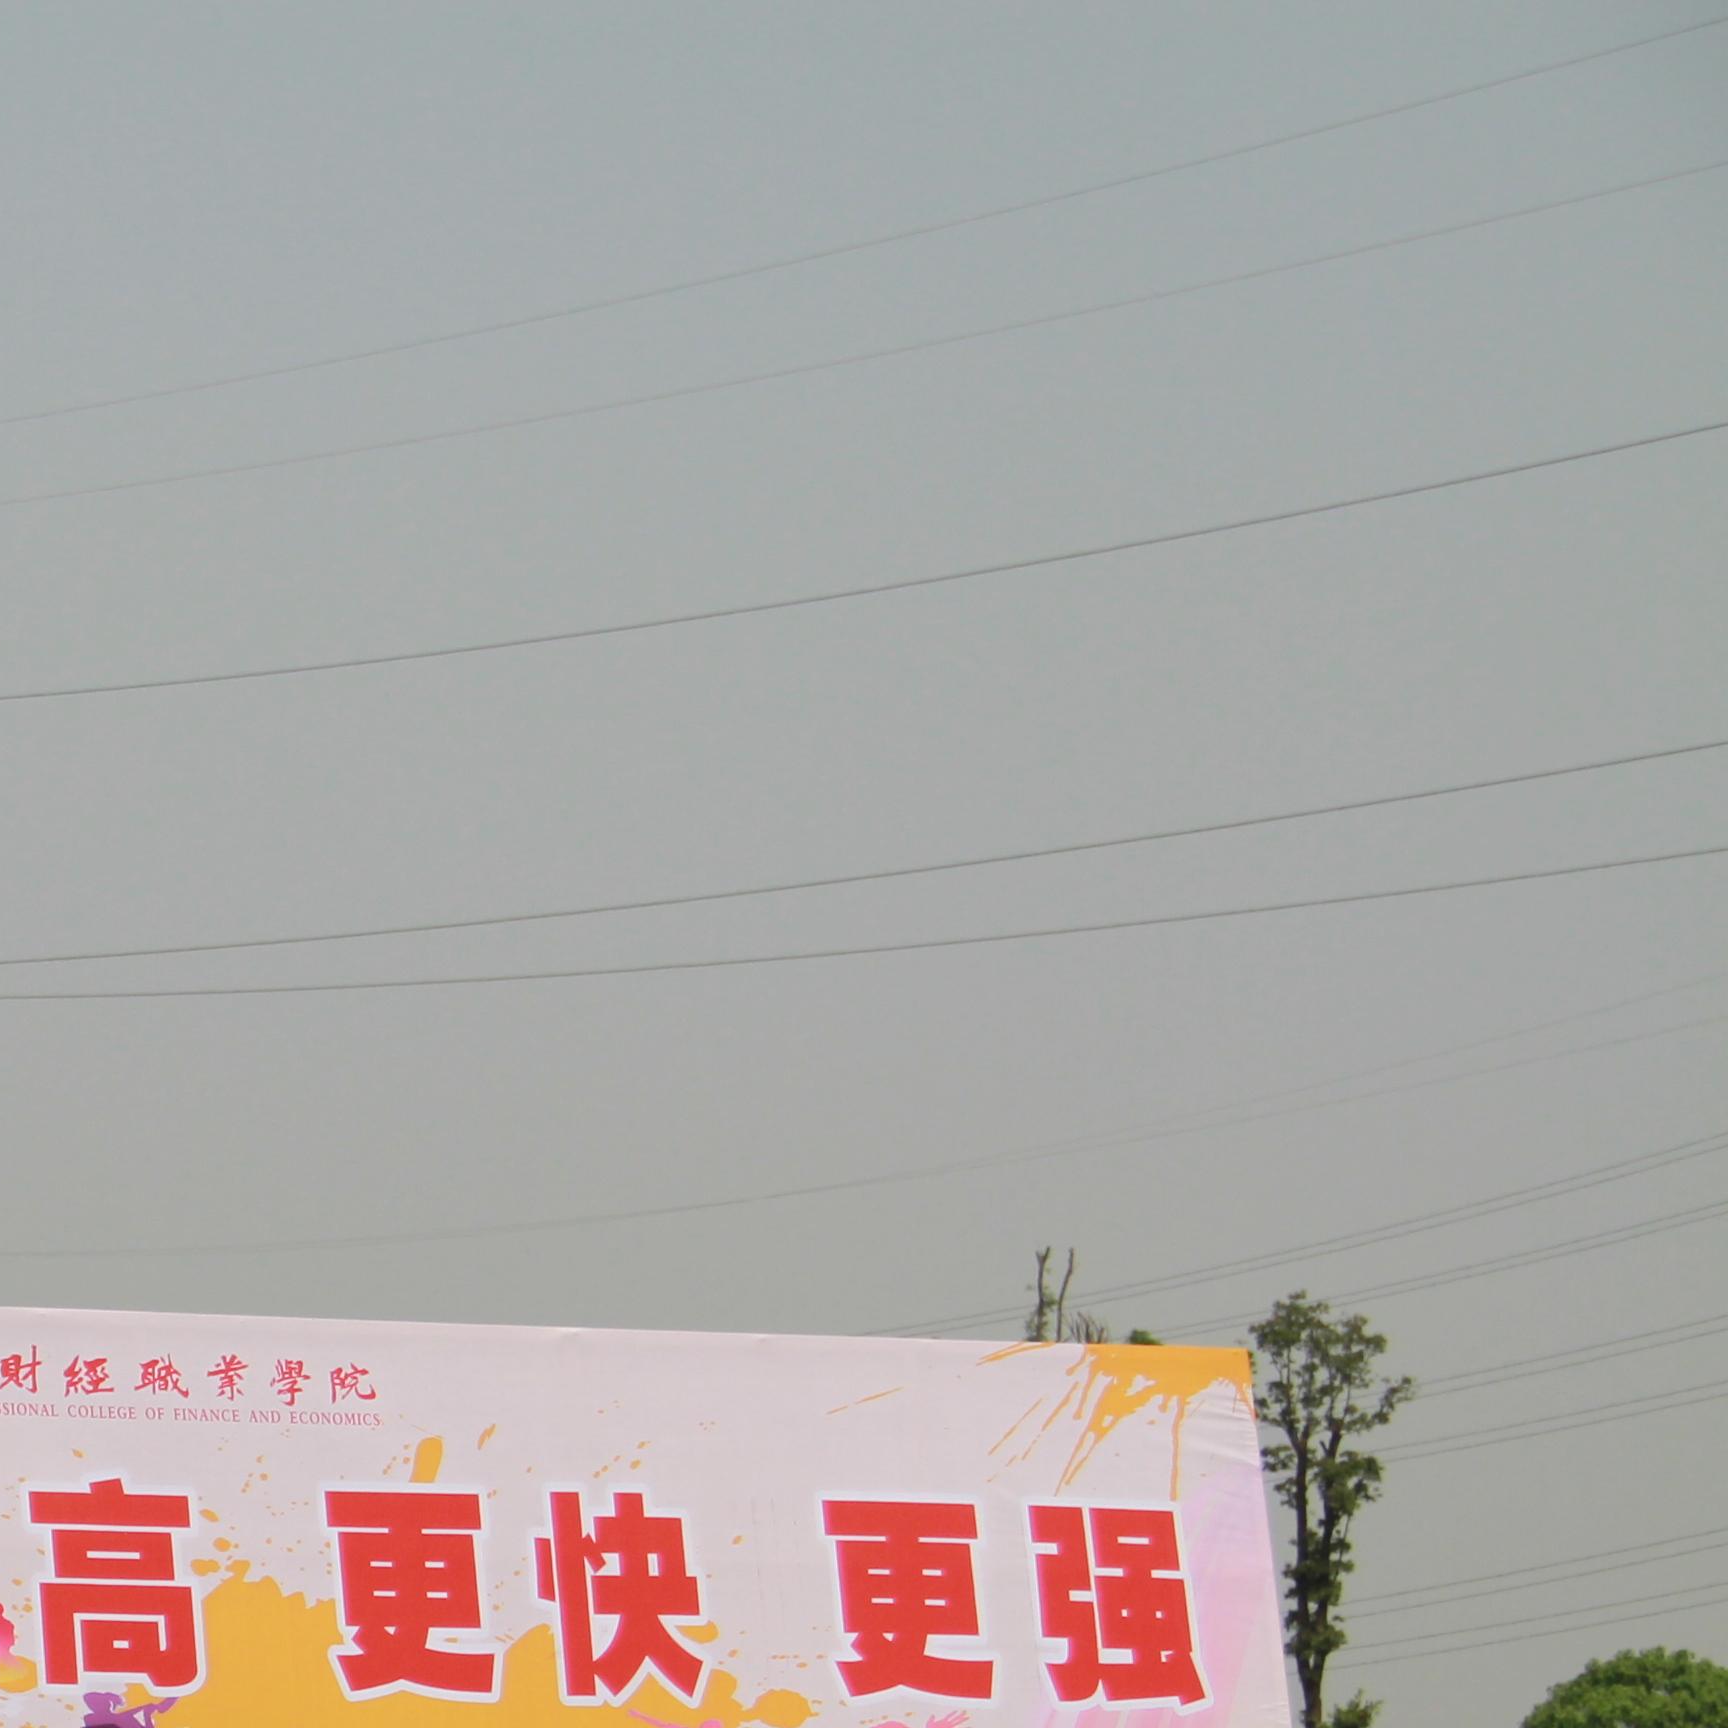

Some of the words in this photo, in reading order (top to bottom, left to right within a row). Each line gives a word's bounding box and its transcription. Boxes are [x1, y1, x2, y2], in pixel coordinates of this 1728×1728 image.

[67, 1404, 137, 1419] COLLEGE
[145, 1407, 165, 1419] OF
[173, 1408, 241, 1423] FINANCE
[248, 1410, 281, 1424] AND
[290, 1411, 382, 1426] ECONOMICS
[325, 1490, 704, 1698] 更快
[823, 1499, 1207, 1705] 更强
